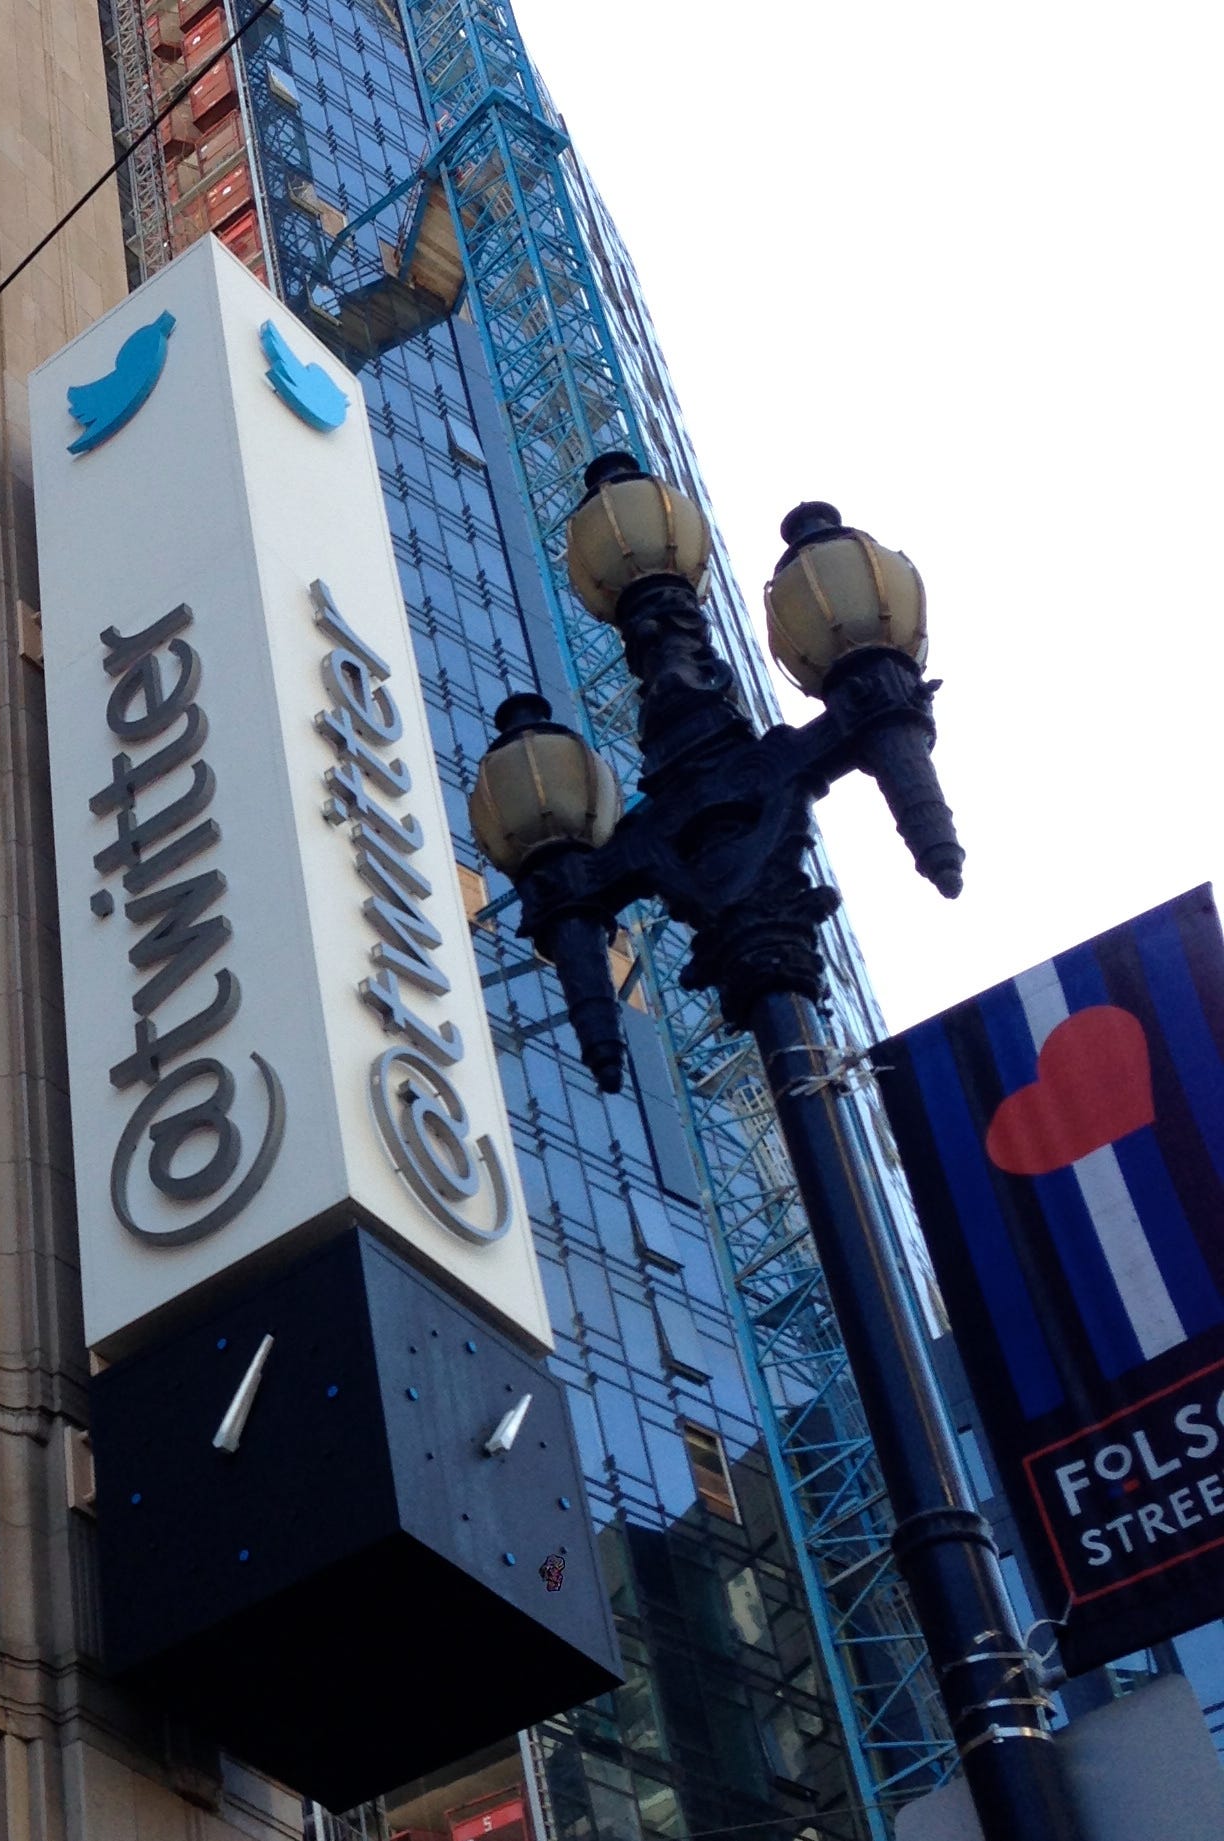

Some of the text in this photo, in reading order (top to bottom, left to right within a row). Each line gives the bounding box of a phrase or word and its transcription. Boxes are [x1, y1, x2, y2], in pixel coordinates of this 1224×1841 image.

[89, 602, 287, 1248] @twitter
[309, 577, 514, 1246] @twitter
[1054, 1388, 1224, 1517] FOLS
[1080, 1468, 1224, 1567] STREE
